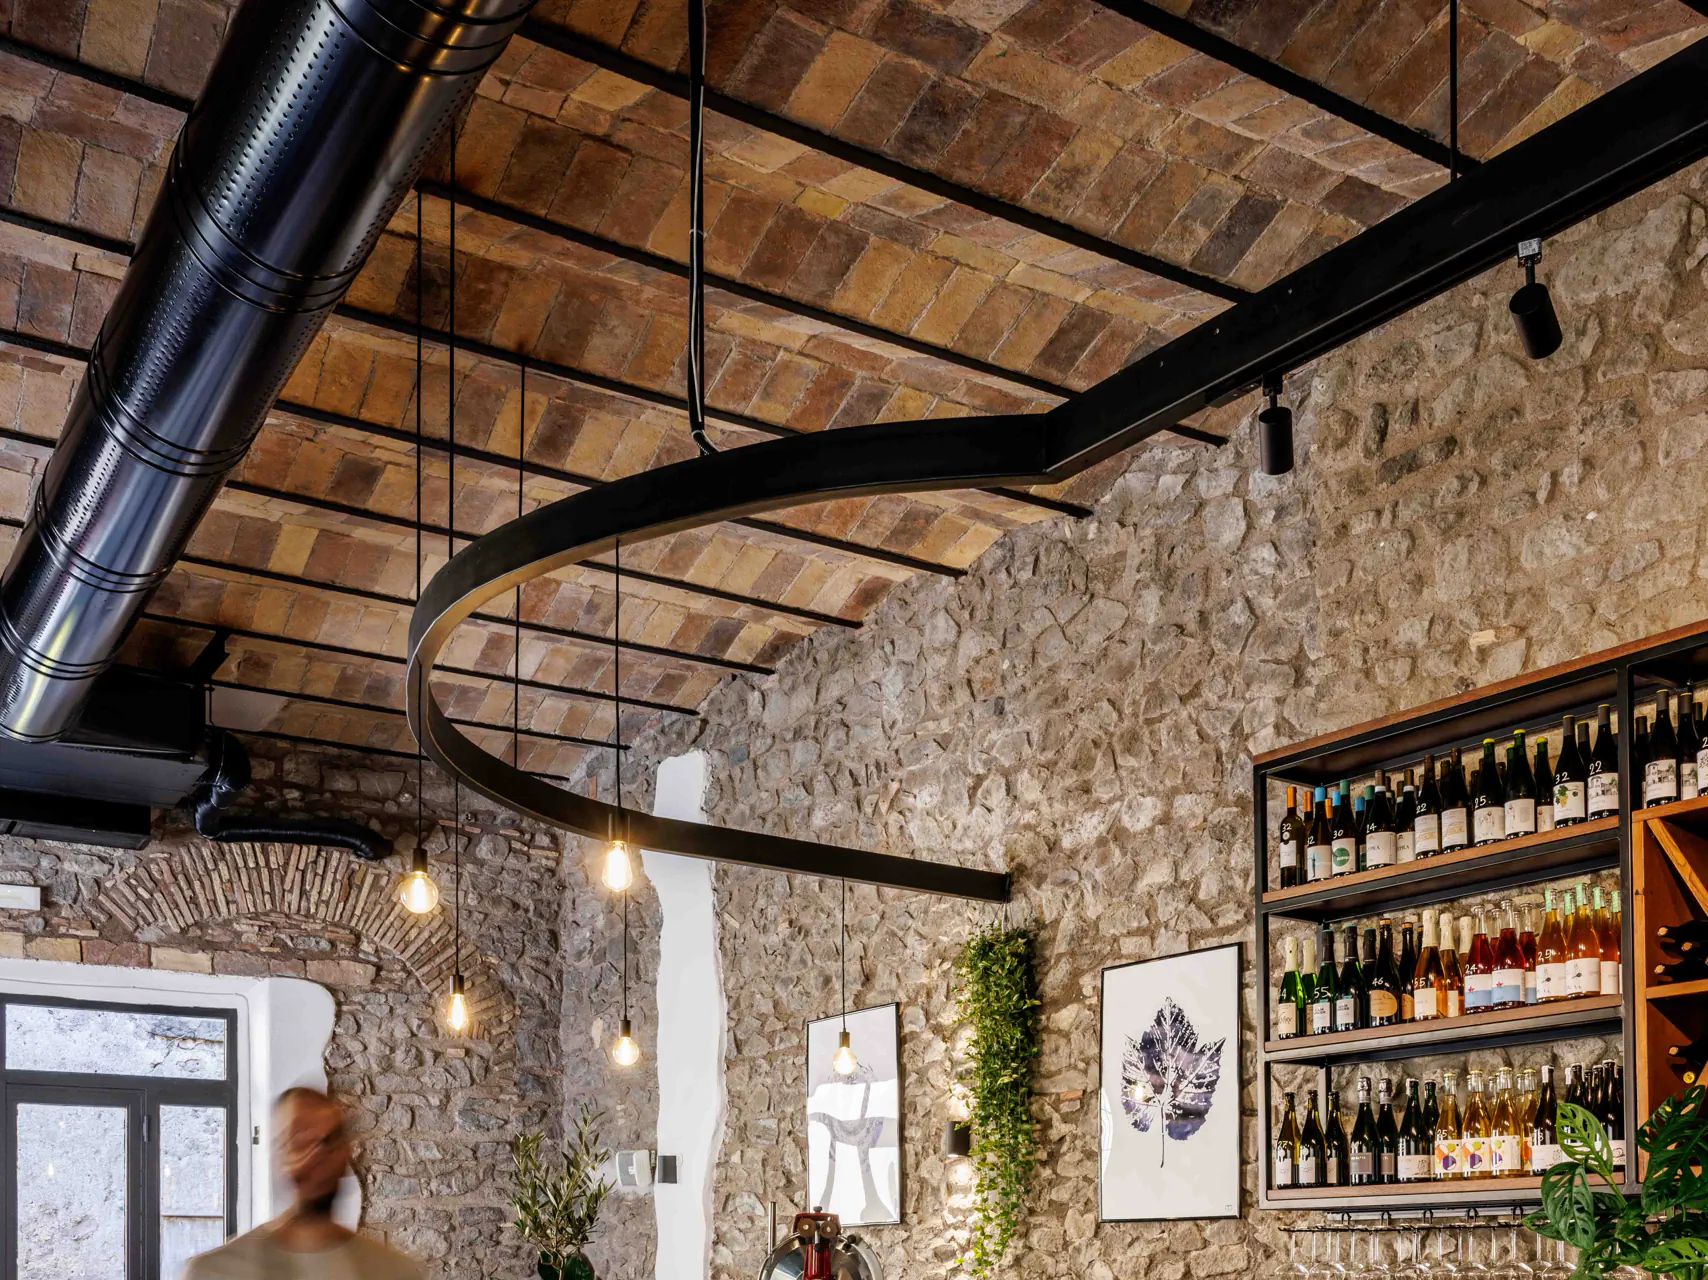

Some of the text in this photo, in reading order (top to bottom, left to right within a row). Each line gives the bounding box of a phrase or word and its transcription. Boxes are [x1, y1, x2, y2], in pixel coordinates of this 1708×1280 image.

[1589, 760, 1602, 775] 22
[1554, 771, 1570, 785] 32
[1474, 795, 1487, 808] 25
[1416, 802, 1427, 814] 22
[1281, 822, 1292, 833] 32
[1333, 829, 1344, 840] 30
[1464, 963, 1478, 975] 24
[1372, 976, 1384, 987] 46
[1314, 986, 1330, 999] 55
